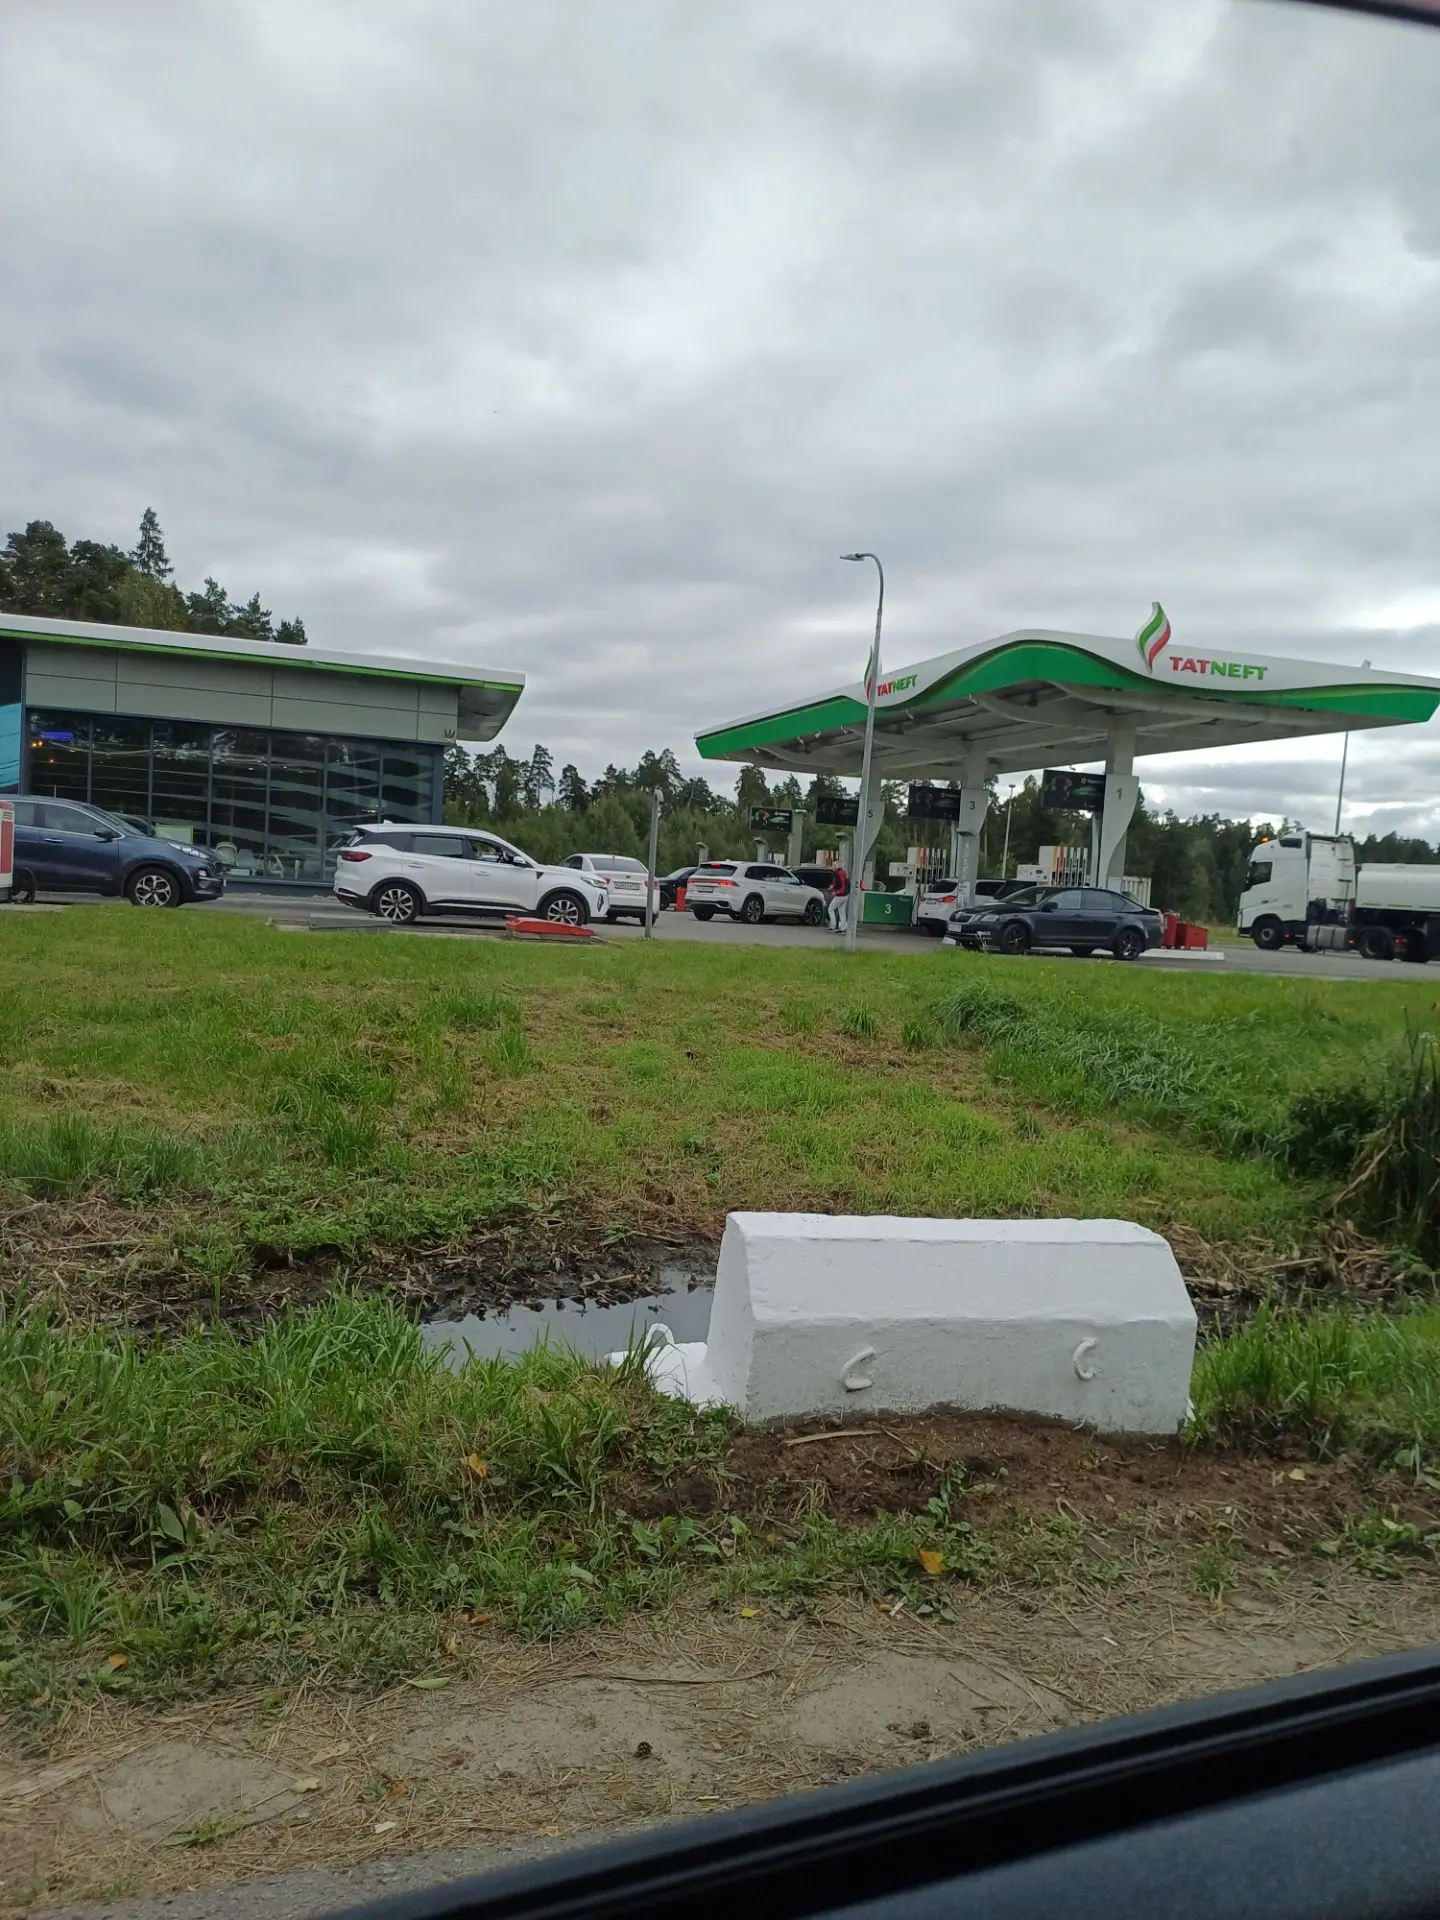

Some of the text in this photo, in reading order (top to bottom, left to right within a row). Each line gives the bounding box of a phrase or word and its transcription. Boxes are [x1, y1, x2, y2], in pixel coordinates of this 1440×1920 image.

[1169, 656, 1268, 680] TATNEFT
[877, 674, 918, 697] TATNEFT
[1116, 788, 1122, 799] 1
[968, 801, 976, 810] 3
[868, 809, 874, 818] 5
[884, 903, 892, 914] 3
